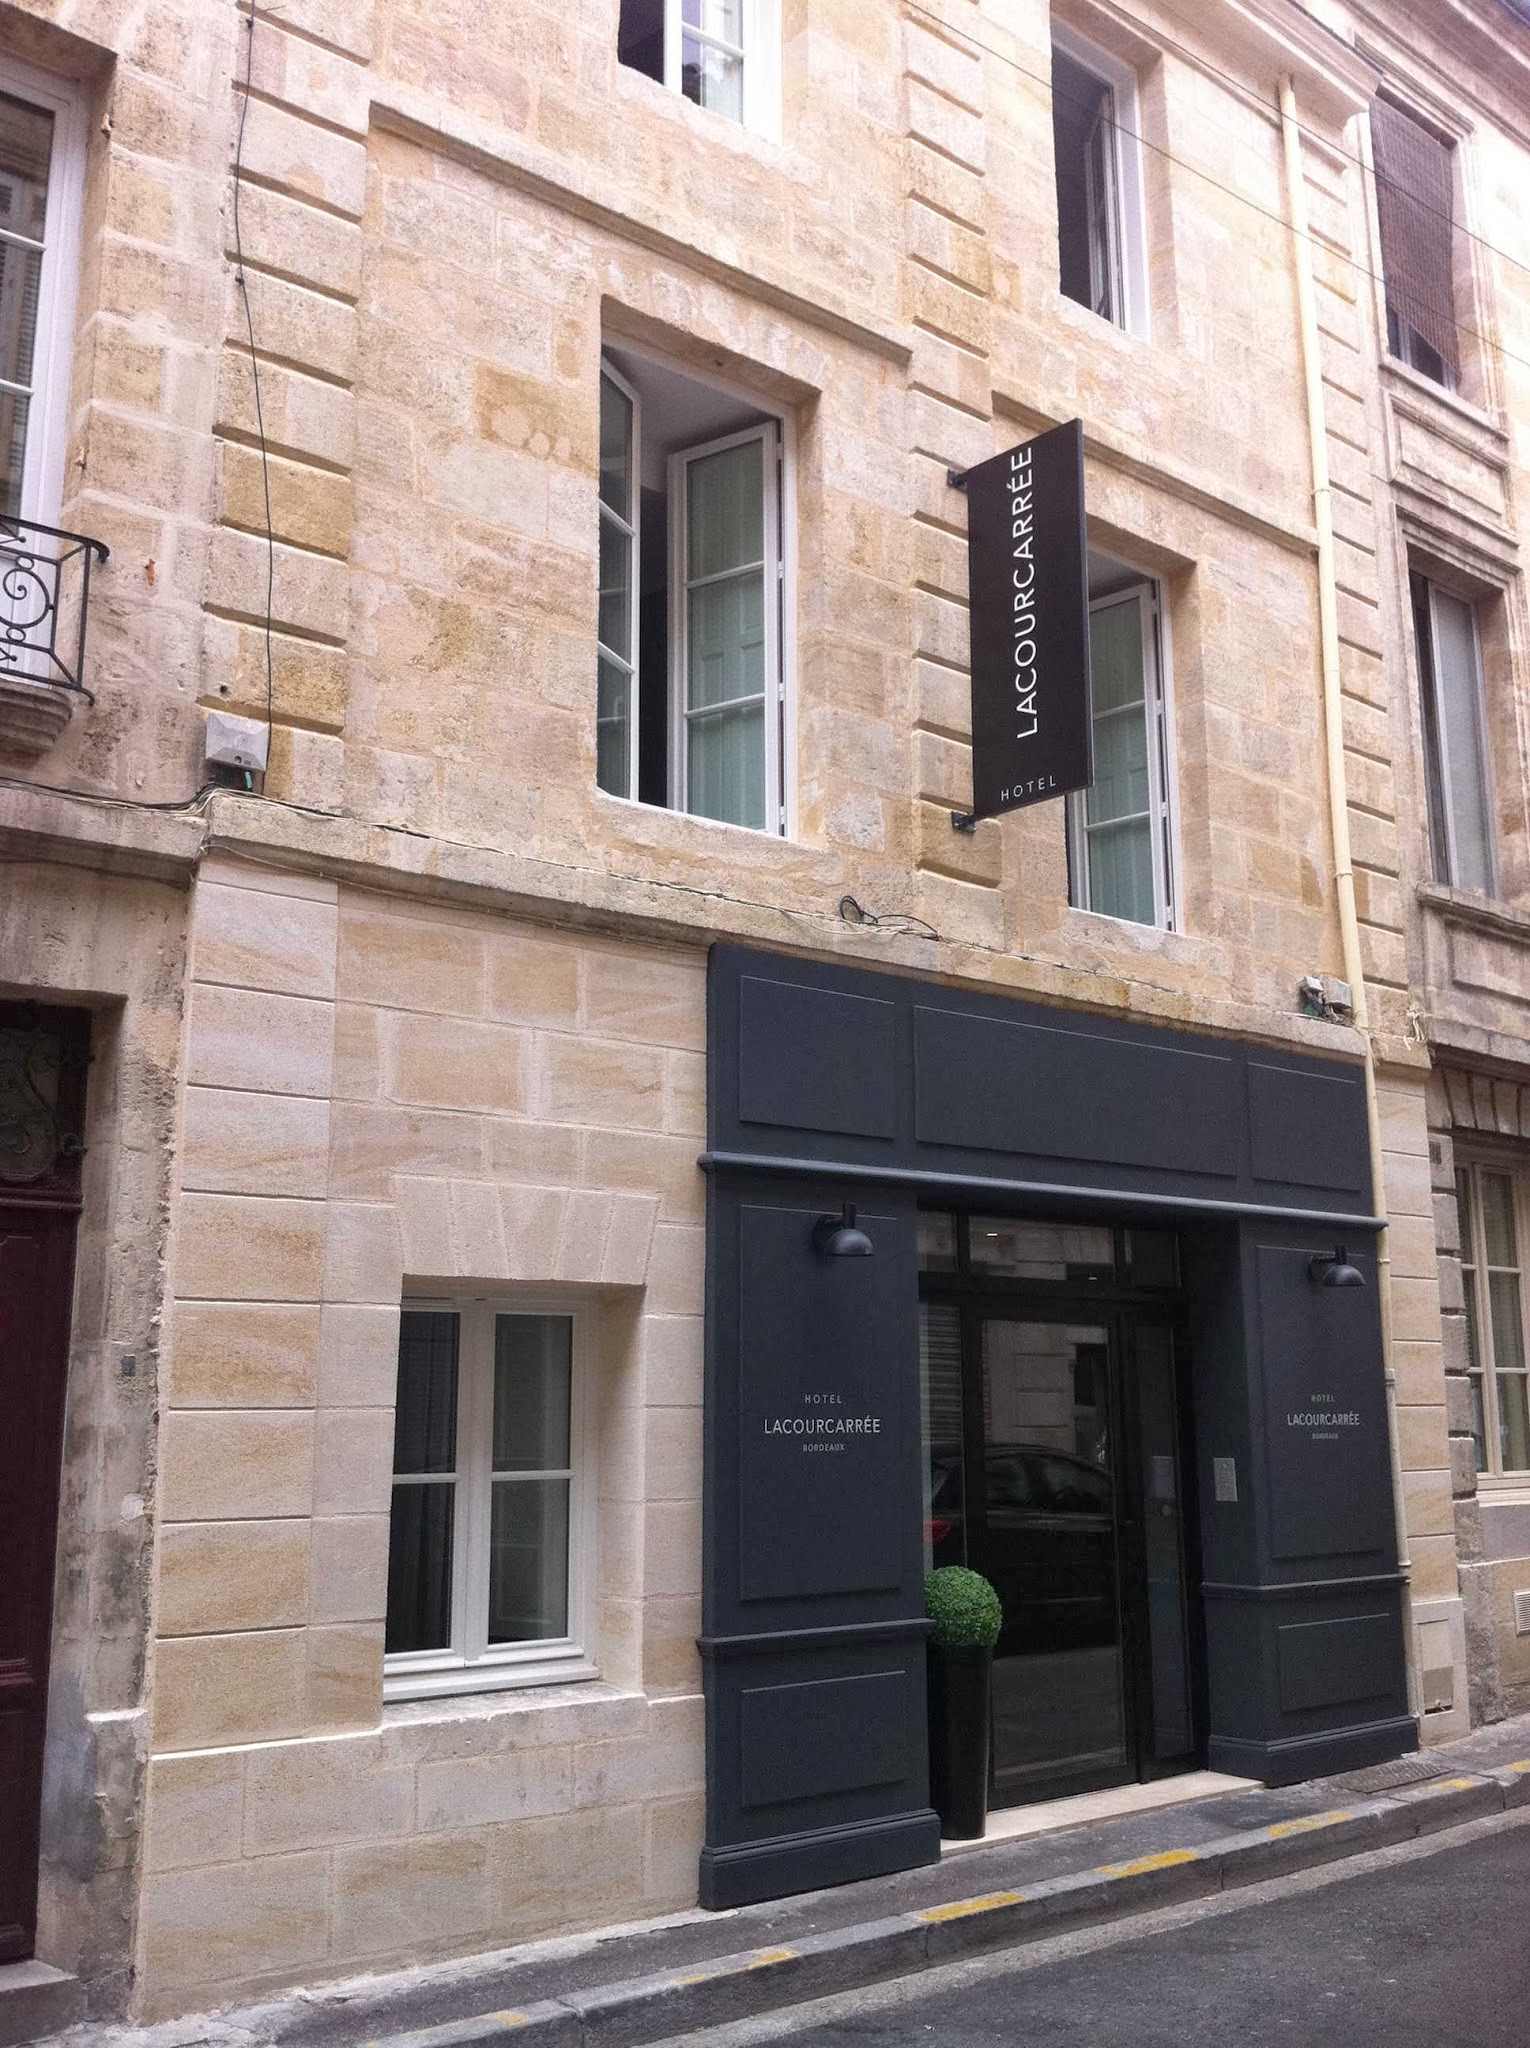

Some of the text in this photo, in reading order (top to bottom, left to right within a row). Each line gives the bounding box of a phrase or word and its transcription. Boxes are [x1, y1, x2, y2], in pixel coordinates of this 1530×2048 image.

[1006, 447, 1038, 739] LACOURCARRÉE
[1001, 775, 1056, 801] HOTEL
[804, 1394, 842, 1404] HOTEL
[764, 1415, 881, 1434] LACOURCARRÉE
[1287, 1411, 1360, 1426] LACOURCARRÉE
